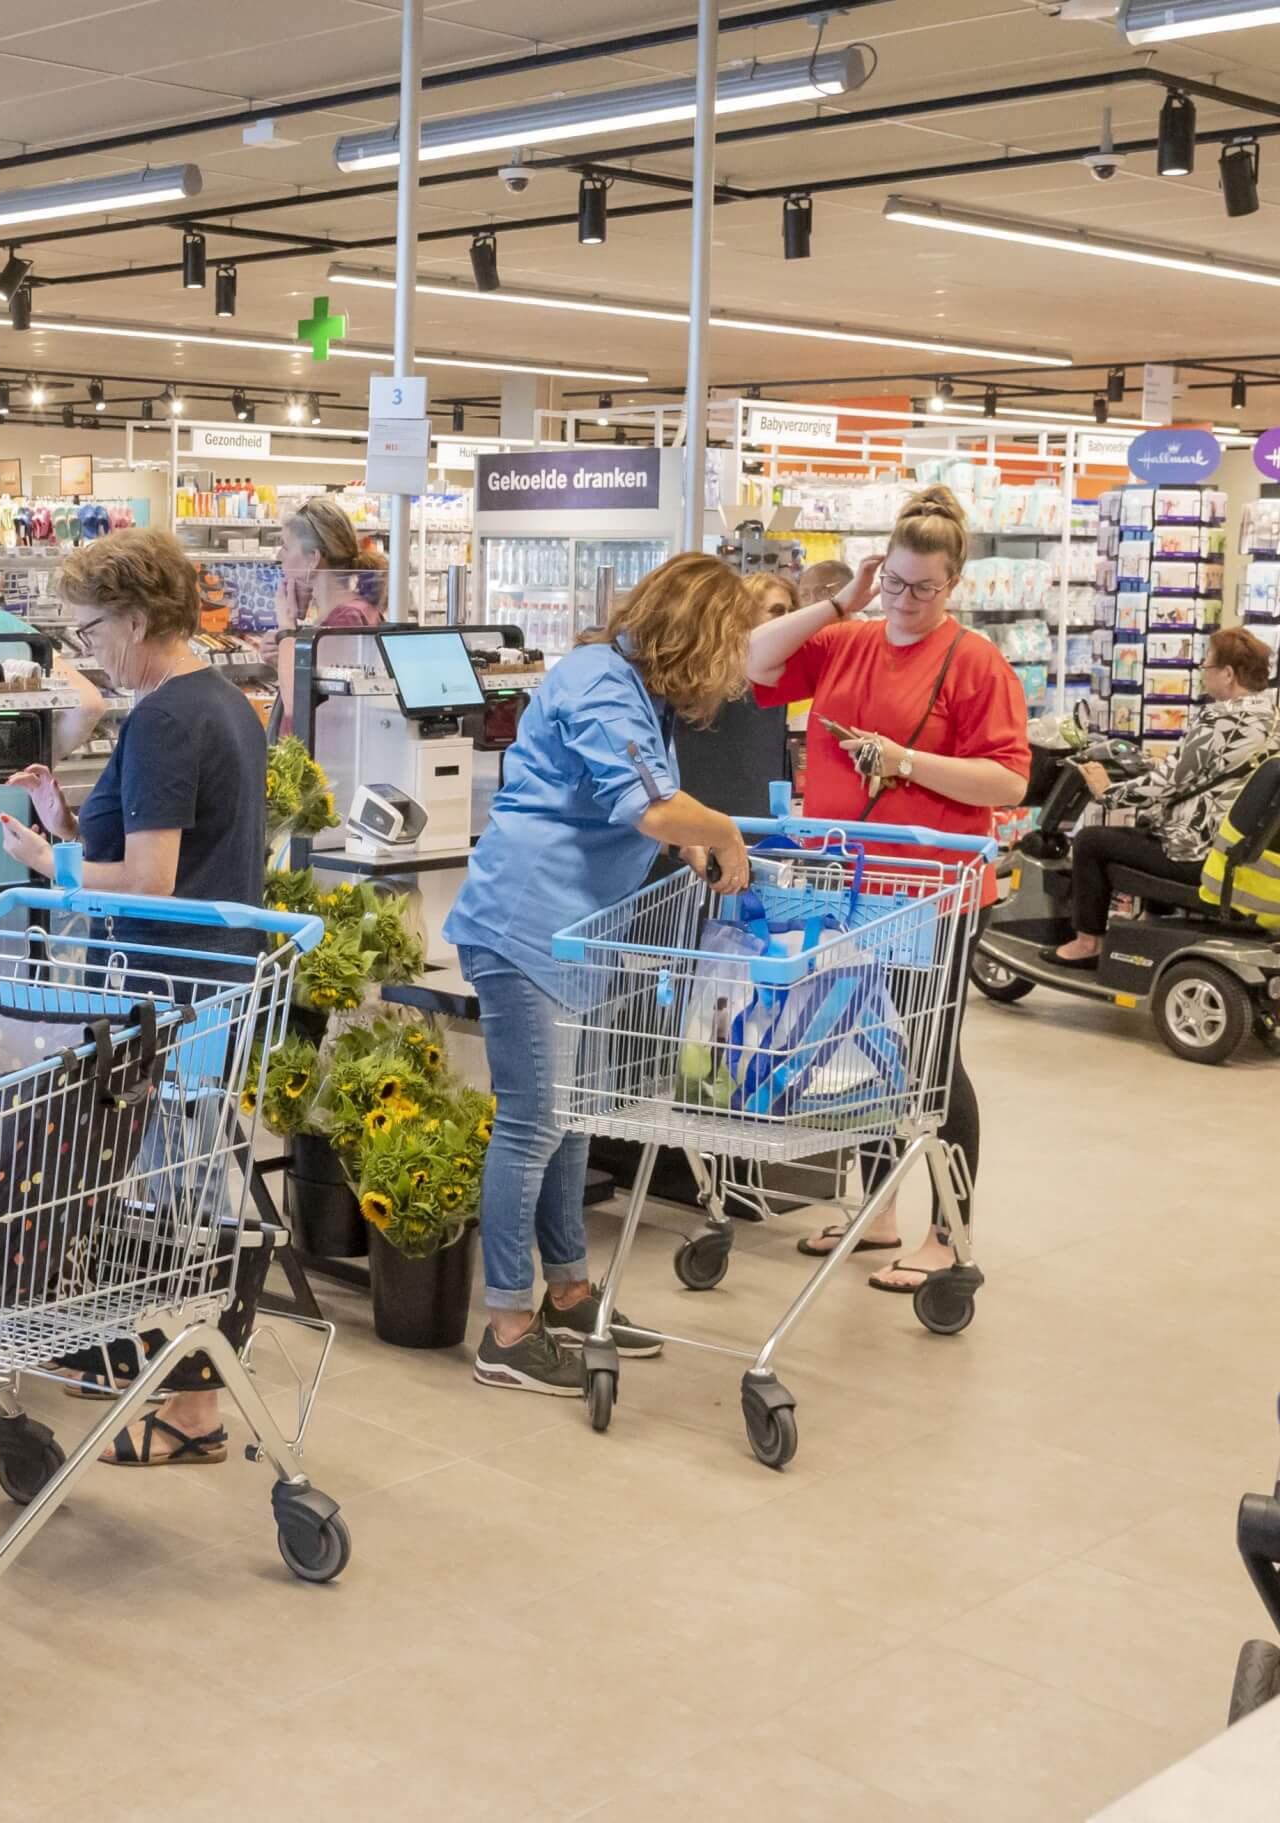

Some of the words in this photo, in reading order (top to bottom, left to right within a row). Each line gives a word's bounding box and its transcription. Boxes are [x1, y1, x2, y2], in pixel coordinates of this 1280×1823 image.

[391, 388, 402, 405] 3
[760, 416, 832, 437] Babyverzorging
[204, 432, 262, 448] Gezondheid
[1137, 449, 1209, 470] Hallmark
[487, 468, 567, 491] Gekoelde
[573, 466, 648, 489] dranken
